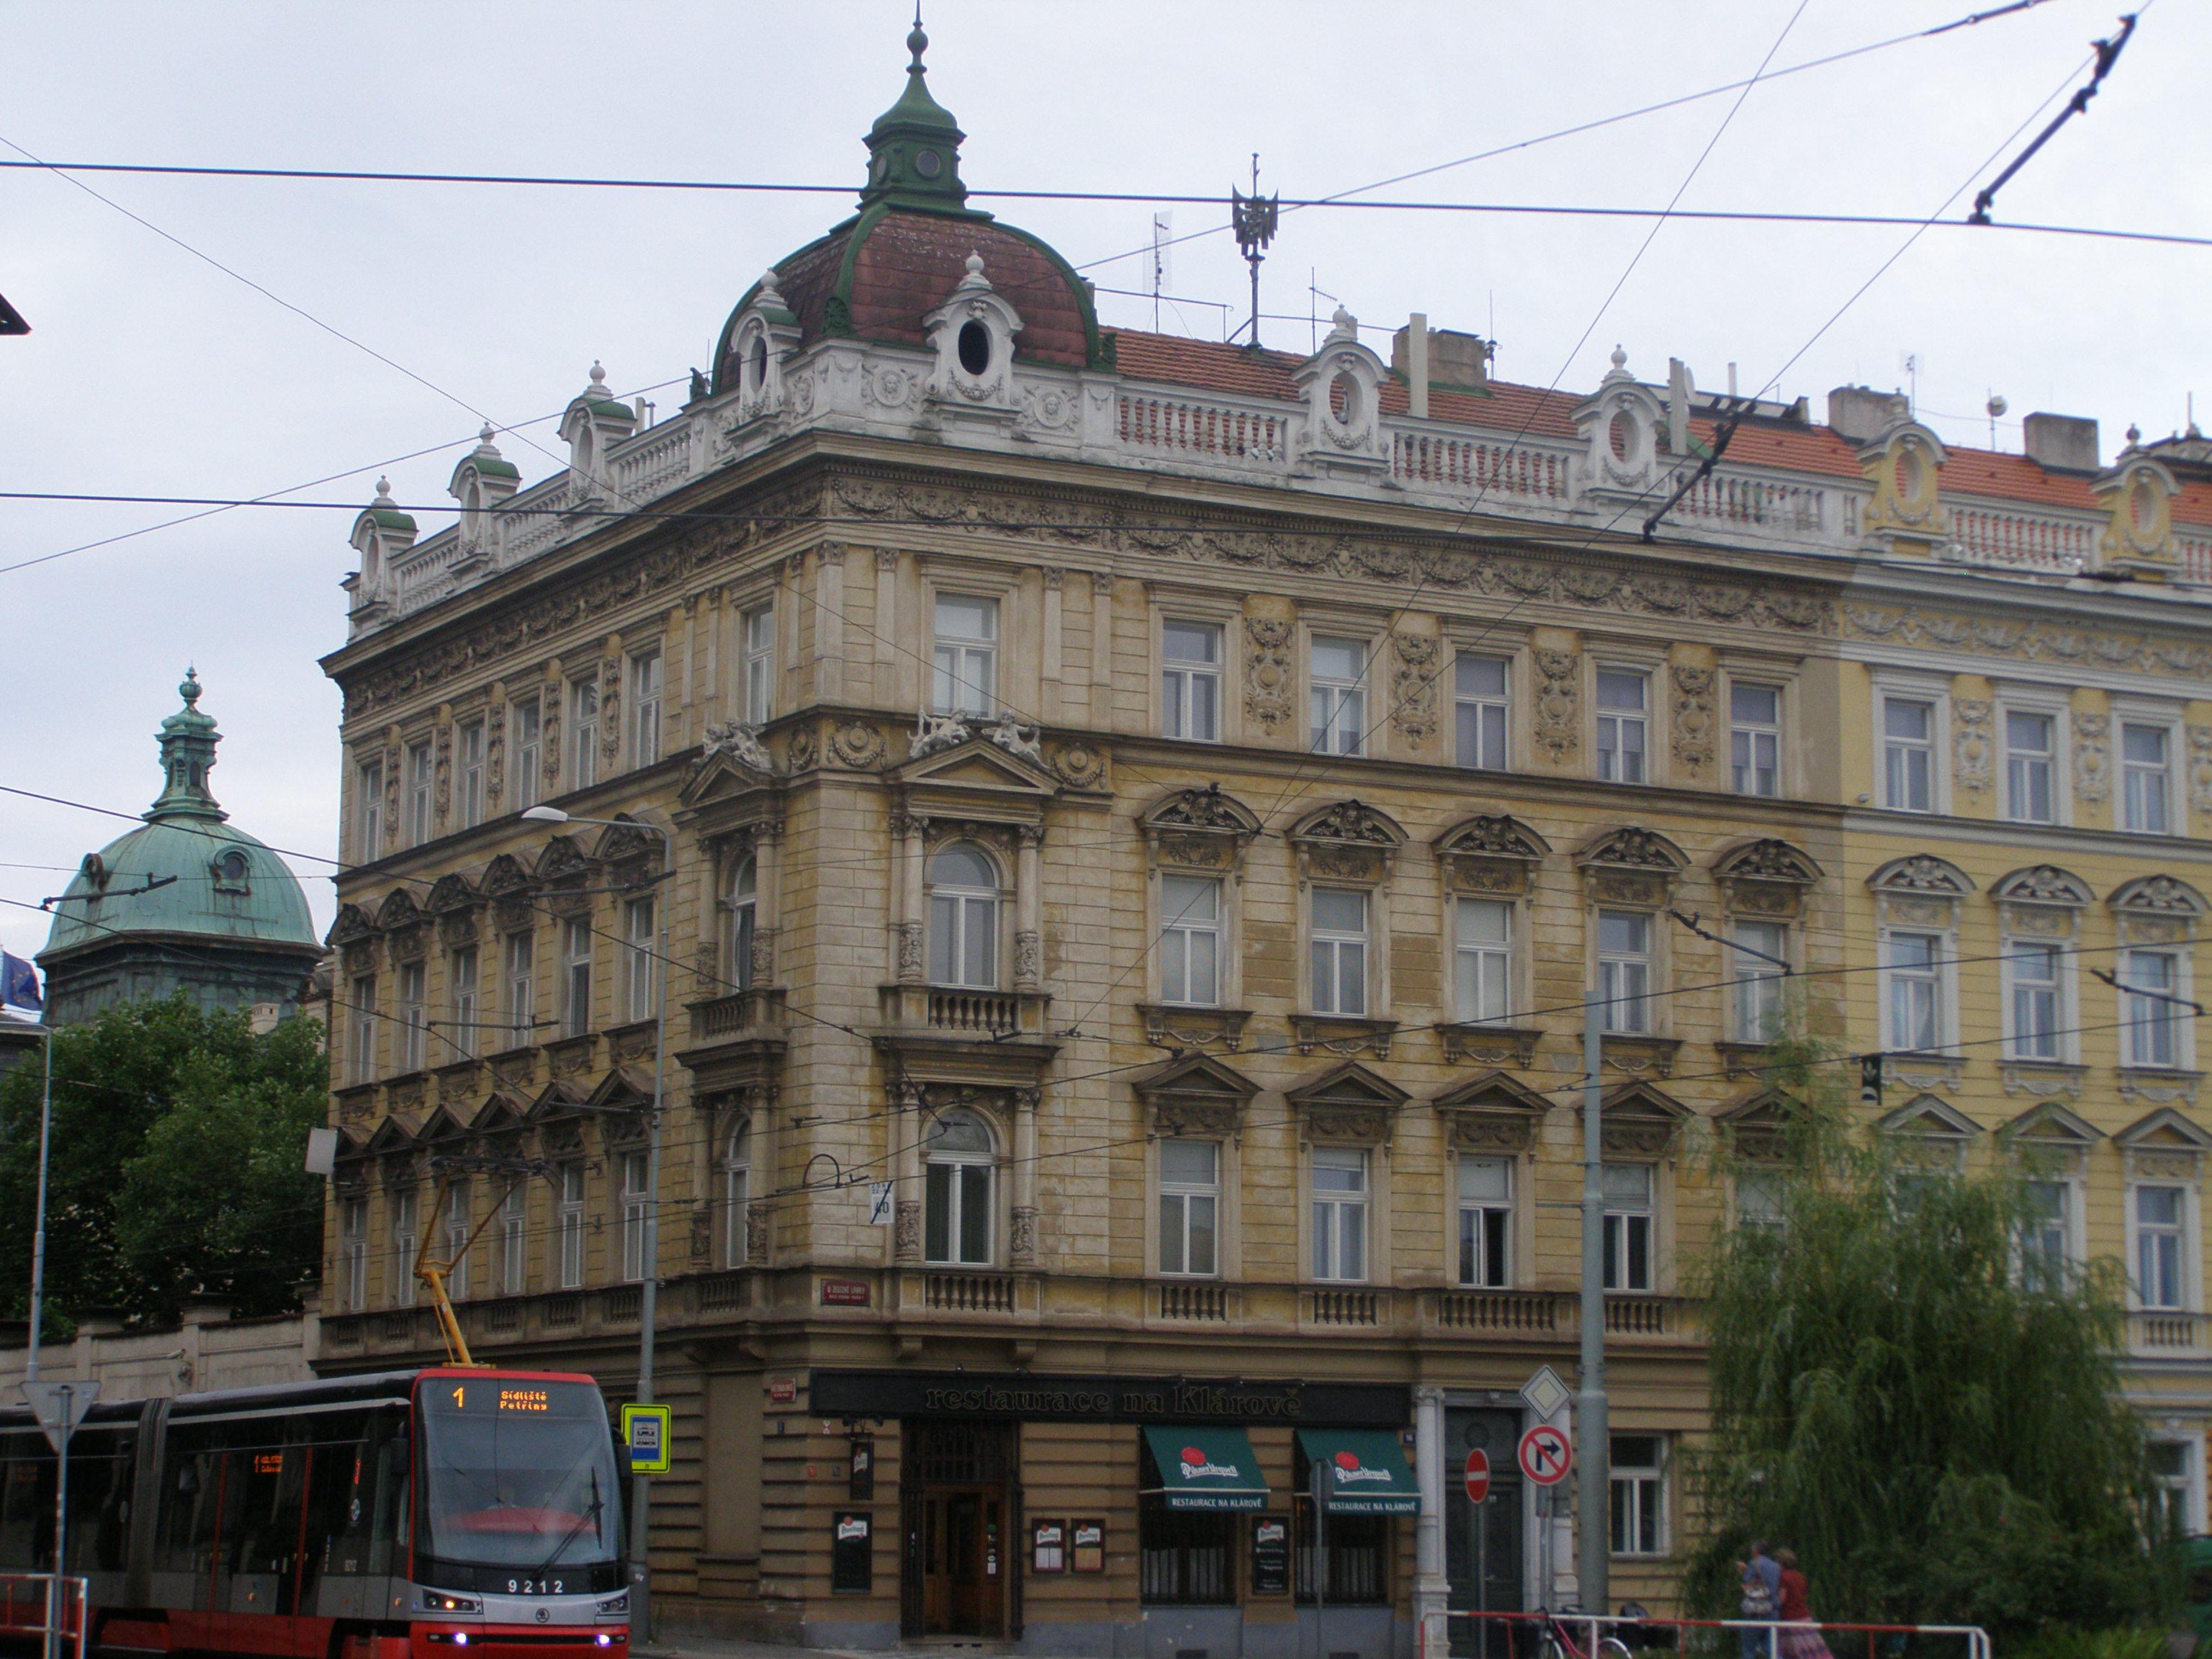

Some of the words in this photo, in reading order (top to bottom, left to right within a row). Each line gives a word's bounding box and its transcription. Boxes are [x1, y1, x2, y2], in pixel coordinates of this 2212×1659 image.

[875, 1202, 889, 1213] 40
[453, 1387, 464, 1408] 1
[501, 1390, 547, 1401] Sídliště
[926, 1385, 1110, 1412] restaurace
[1124, 1391, 1164, 1413] na
[1174, 1385, 1301, 1416] Klárově
[500, 1401, 547, 1411] Petřiny
[1181, 1462, 1210, 1479] Pilsner
[1207, 1462, 1238, 1477] Urquell
[1172, 1498, 1217, 1507] RESTAURACE
[1218, 1498, 1228, 1507] NA
[1230, 1498, 1262, 1508] KLÁROVĚ
[1328, 1501, 1371, 1511] RESTAURACE
[1372, 1502, 1383, 1511] NA
[1385, 1501, 1416, 1511] KLÁROVĚ
[508, 1579, 563, 1593] 9212
